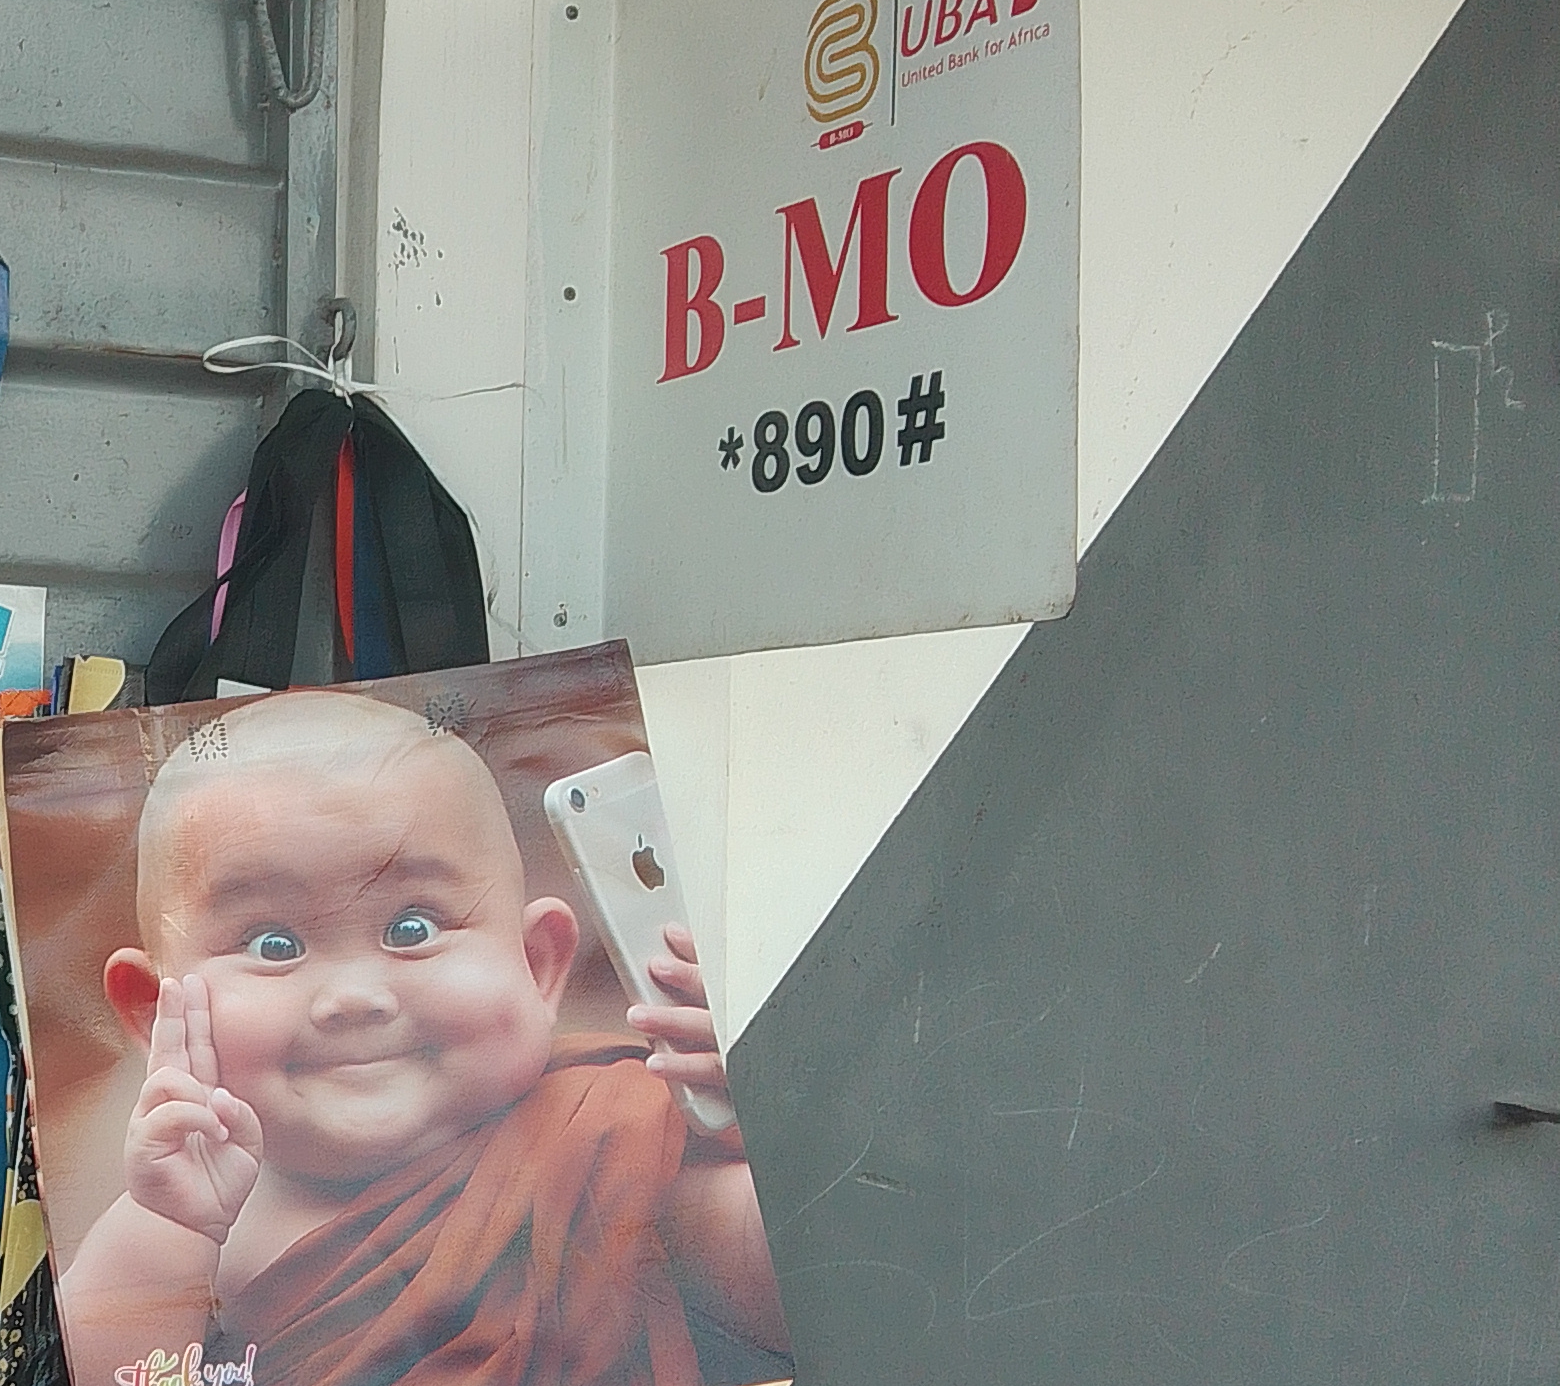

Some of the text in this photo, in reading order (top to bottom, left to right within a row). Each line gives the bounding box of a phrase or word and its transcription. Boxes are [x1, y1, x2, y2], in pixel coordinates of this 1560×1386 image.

[901, 23, 1050, 88] United Bank for Africa
[656, 141, 1027, 384] B-MO
